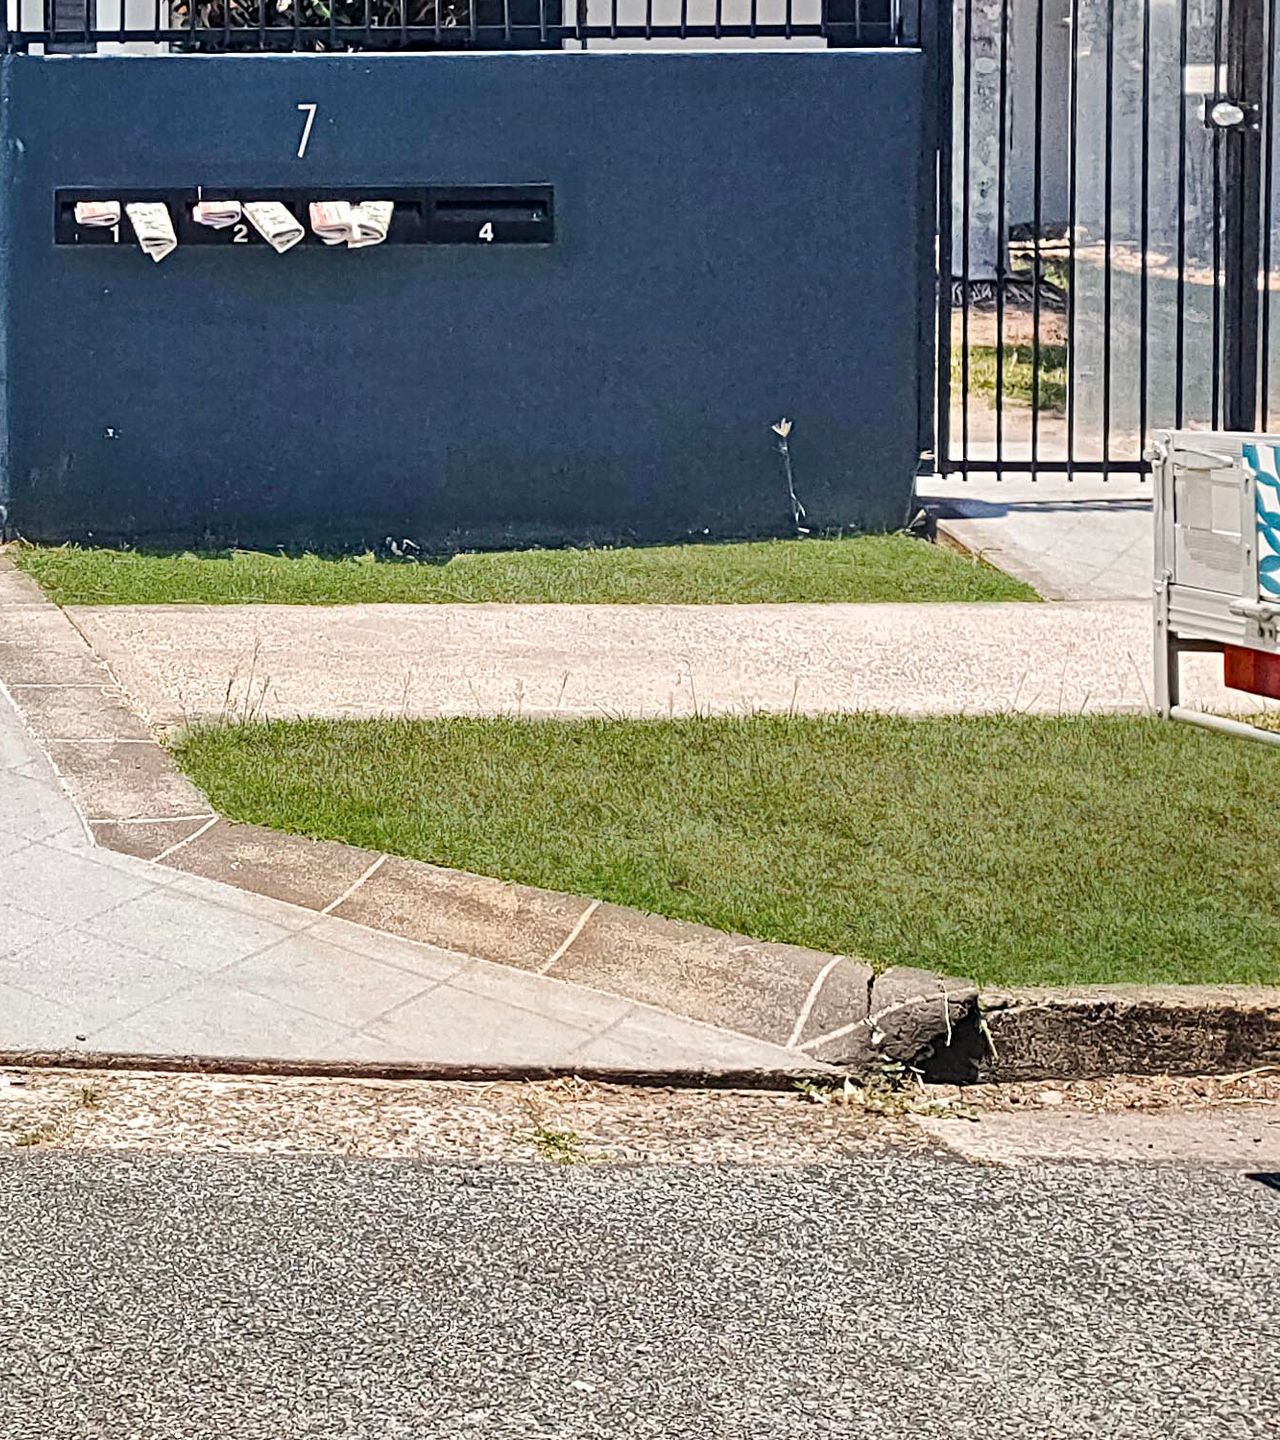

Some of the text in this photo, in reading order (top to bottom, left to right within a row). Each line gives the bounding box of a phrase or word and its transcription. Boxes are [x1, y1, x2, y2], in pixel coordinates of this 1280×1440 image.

[297, 103, 317, 158] 7
[109, 224, 120, 243] 1
[233, 224, 249, 243] 2
[478, 222, 494, 242] 4
